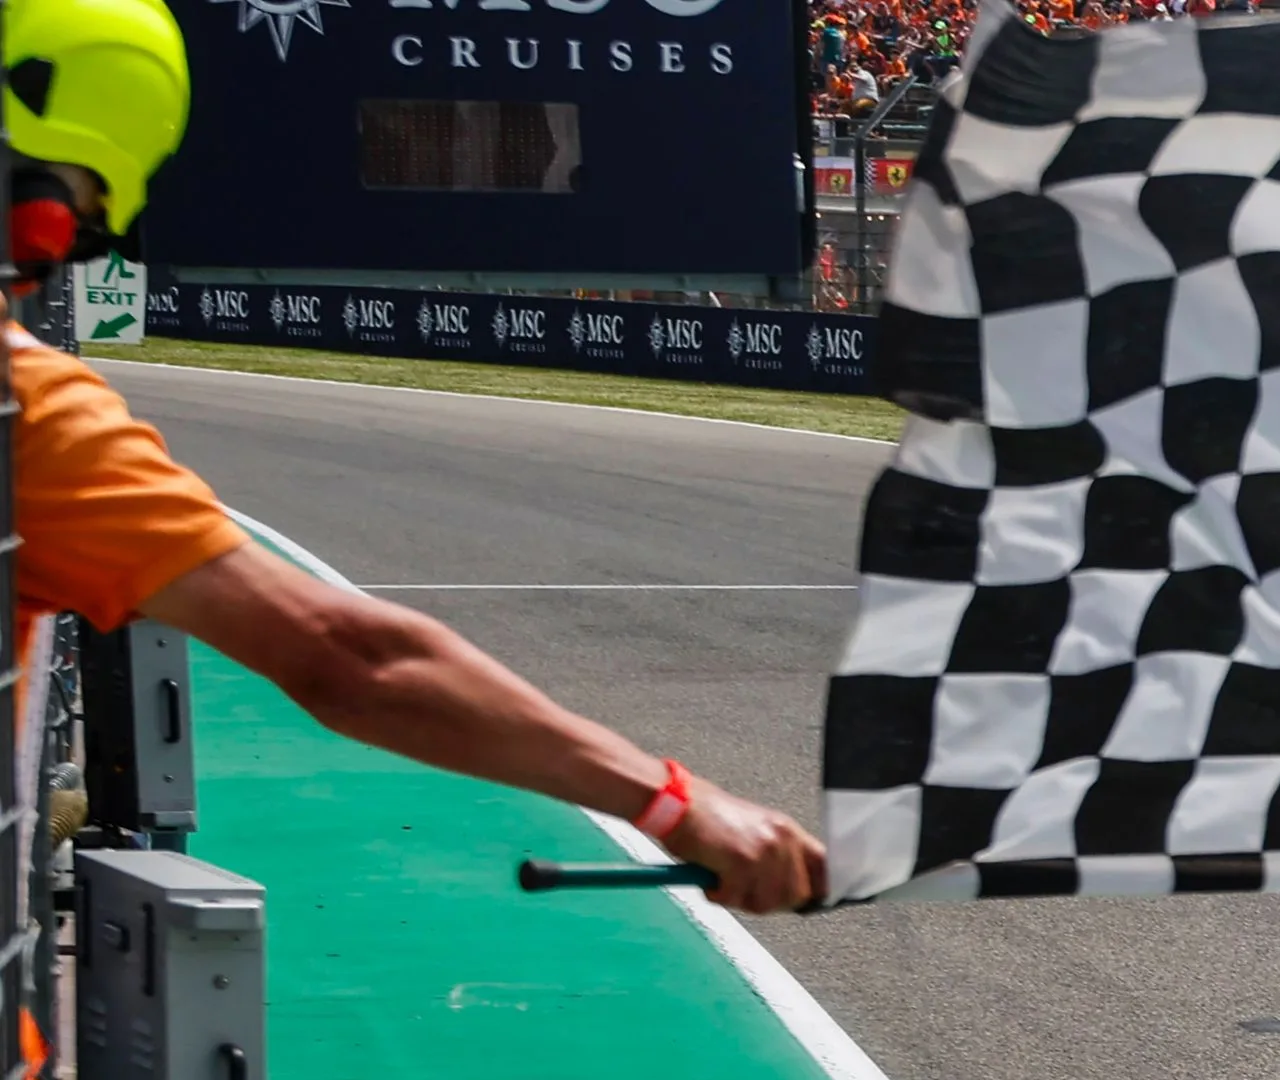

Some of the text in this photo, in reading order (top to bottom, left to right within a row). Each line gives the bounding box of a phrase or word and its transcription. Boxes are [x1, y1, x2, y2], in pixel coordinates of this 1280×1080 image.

[391, 35, 734, 75] CRUISES
[87, 291, 137, 305] EXIT
[217, 289, 249, 318] MSC
[288, 295, 320, 323] MSC
[360, 299, 394, 328] MSC
[435, 304, 469, 333] MSC
[510, 309, 545, 338] MSC
[587, 314, 623, 344] MSC
[666, 318, 702, 349] MSC
[746, 323, 781, 354] MSC
[826, 328, 863, 360] MSC
